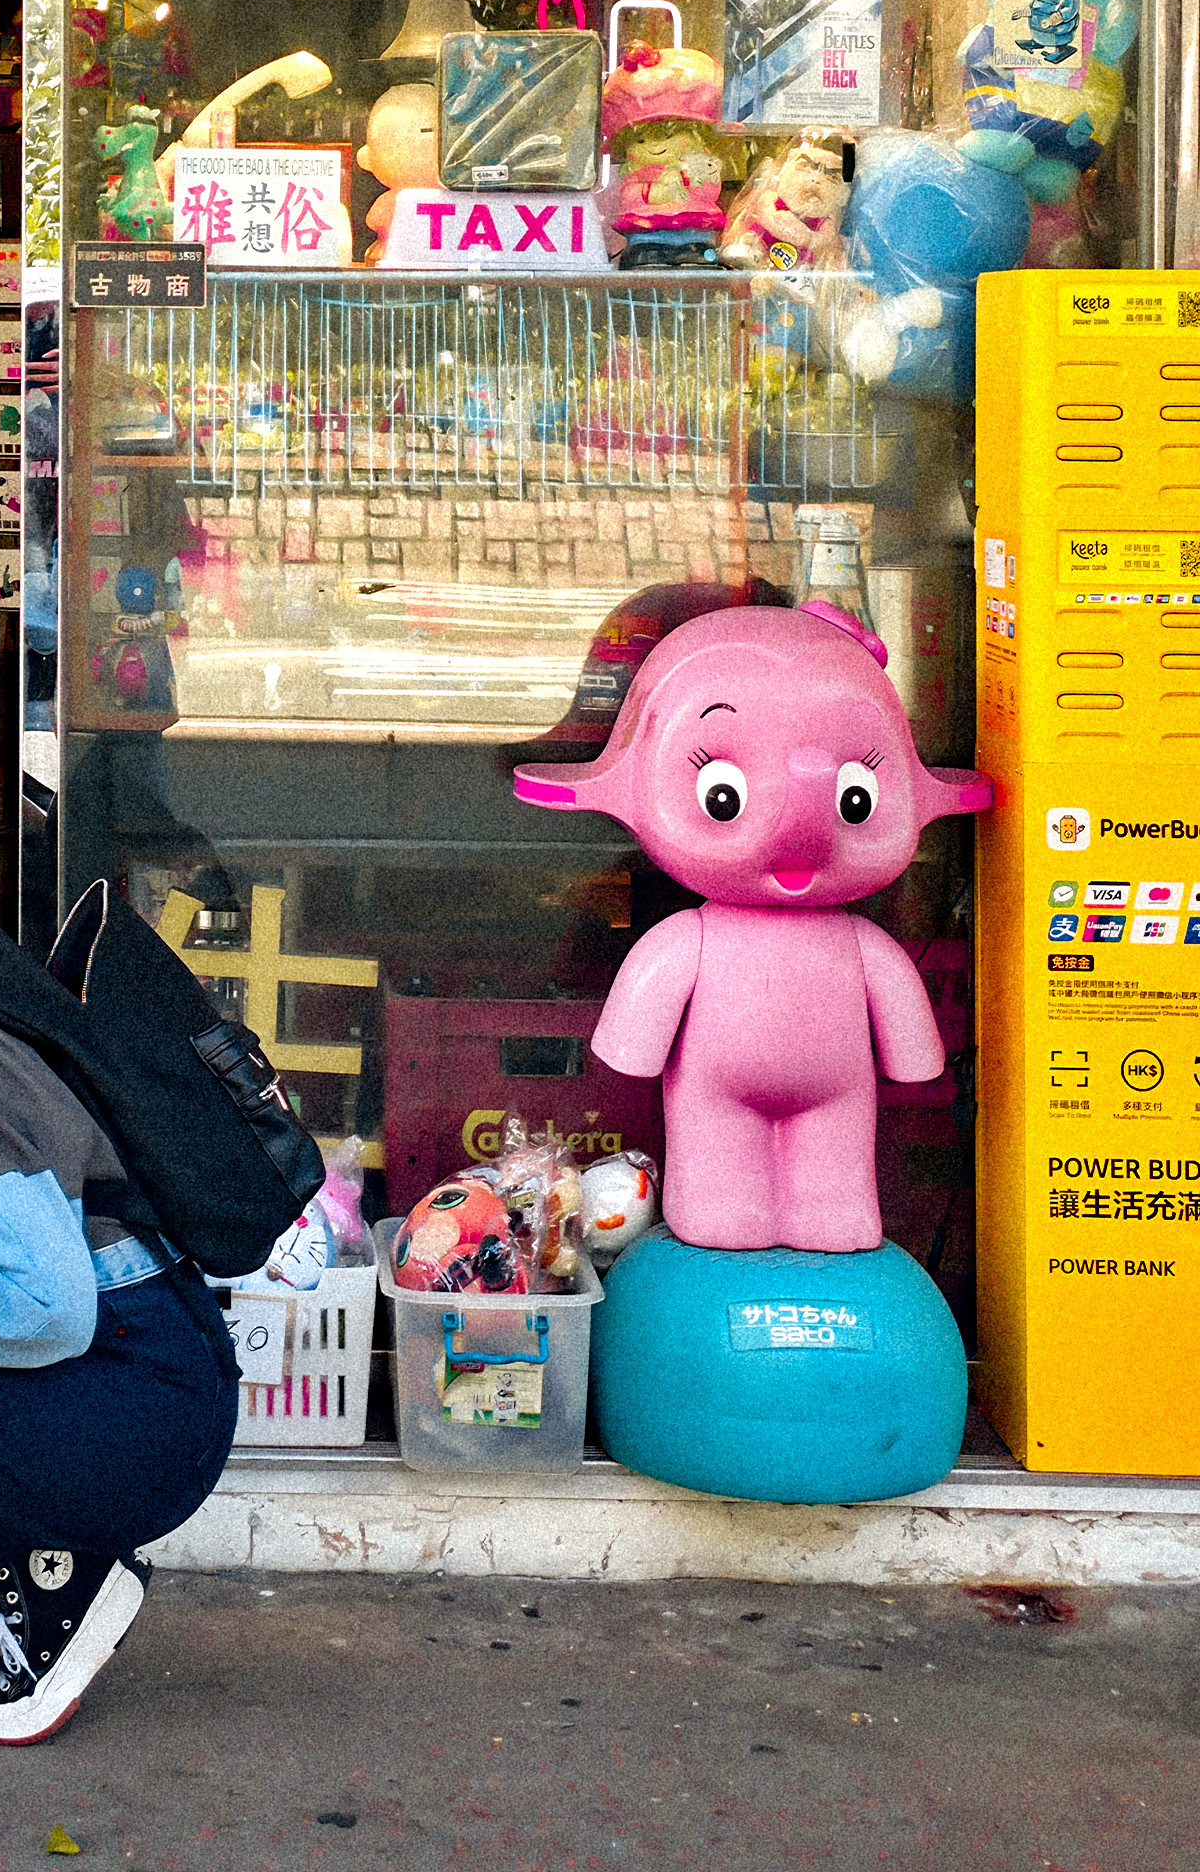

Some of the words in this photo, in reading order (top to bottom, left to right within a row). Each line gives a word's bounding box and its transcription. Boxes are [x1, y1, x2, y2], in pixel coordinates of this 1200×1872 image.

[823, 26, 875, 53] BEATLES
[822, 49, 847, 69] GET
[821, 69, 858, 89] BACK
[181, 157, 198, 174] THE
[200, 158, 226, 175] GOOD
[227, 158, 244, 175] THE
[246, 158, 264, 176] BAD
[265, 159, 271, 175] &
[273, 159, 290, 176] THE
[291, 159, 334, 177] CREATIVE
[180, 180, 237, 258] 雅
[240, 181, 277, 254] 共想
[274, 181, 334, 255] 俗
[415, 203, 584, 254] TAXI
[89, 272, 191, 297] 古物商
[1072, 294, 1111, 314] keeta
[1070, 540, 1109, 560] keeta
[1100, 818, 1200, 840] PowerBu
[1092, 889, 1122, 901] VISA
[1086, 921, 1124, 931] UnionPay
[1051, 955, 1091, 970] 免按金
[1127, 1064, 1158, 1078] HK$
[1048, 1157, 1141, 1180] POWER
[1149, 1159, 1200, 1181] BUD
[1048, 1188, 1200, 1222] 讓生活充滿
[1049, 1258, 1119, 1276] POWER
[1124, 1259, 1176, 1277] BANK
[741, 1304, 857, 1326] サトコちゃん
[770, 1326, 835, 1343] sato
